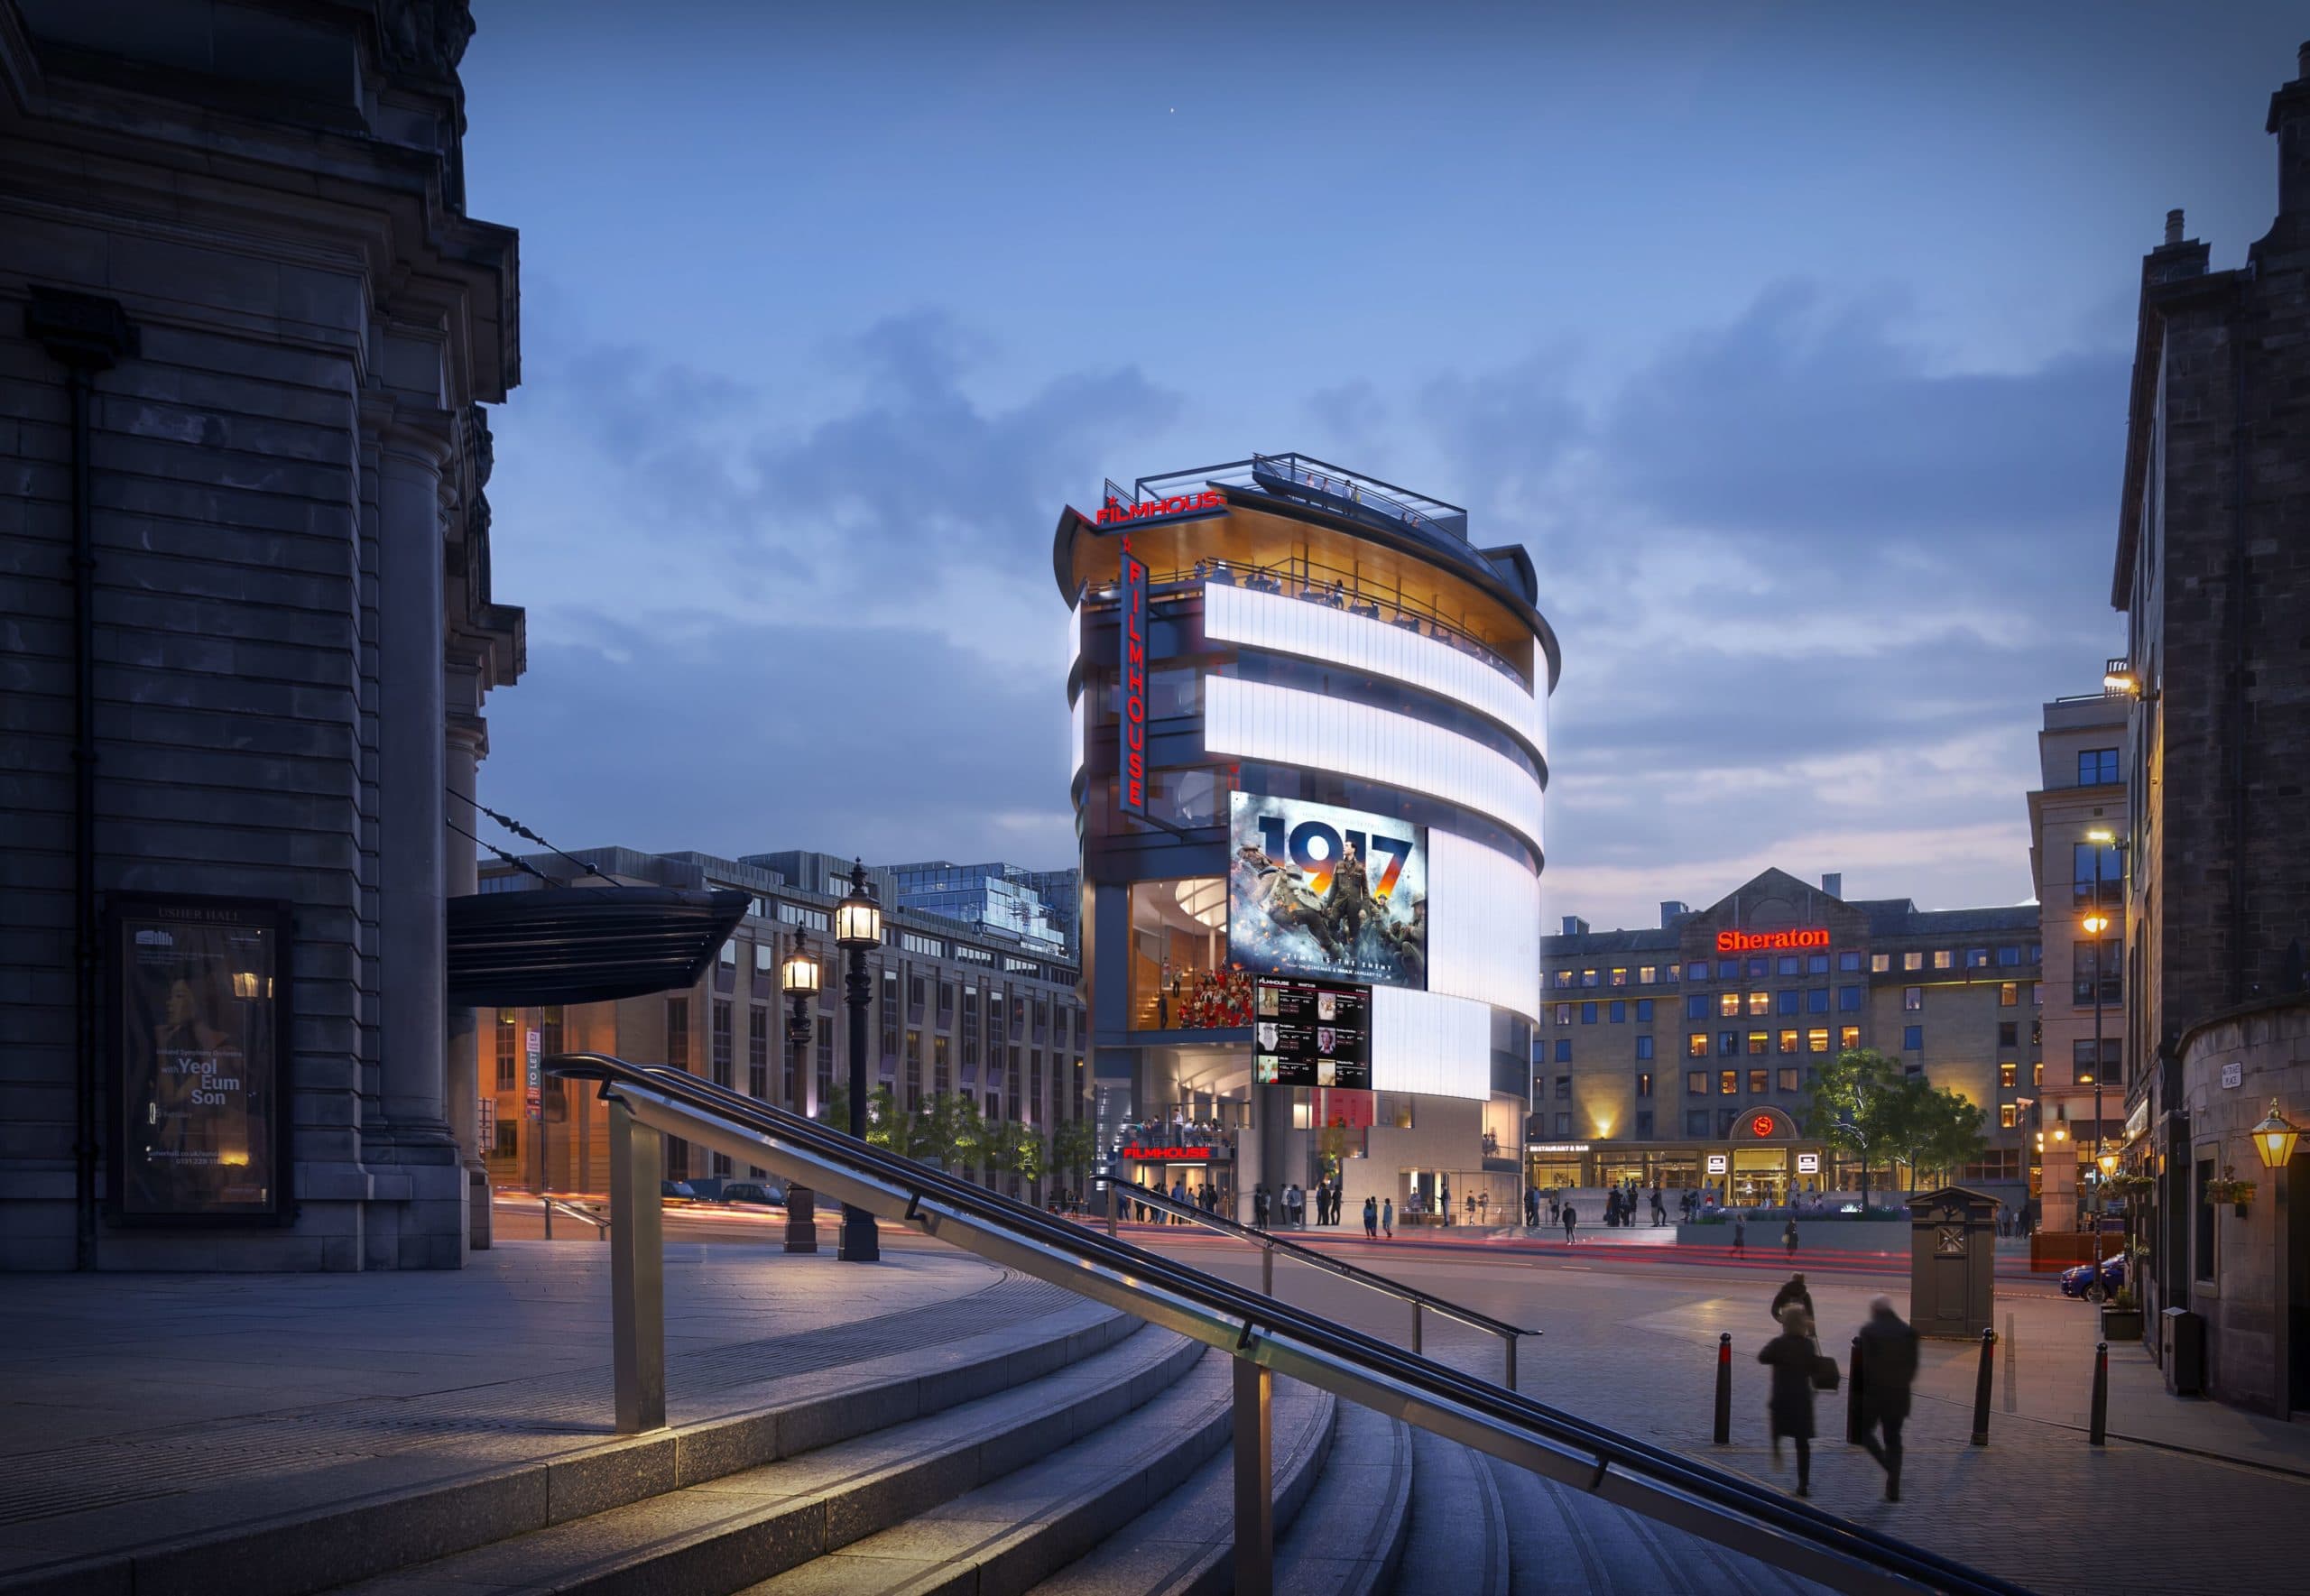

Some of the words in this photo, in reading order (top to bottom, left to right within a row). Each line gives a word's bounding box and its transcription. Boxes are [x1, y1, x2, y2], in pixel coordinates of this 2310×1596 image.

[1128, 560, 1144, 807] FILMHOUSE
[1259, 816, 1413, 901] 1917
[1717, 928, 1829, 951] Sheraton
[1338, 958, 1355, 966] THE
[1363, 961, 1391, 971] ENEMY
[179, 1058, 217, 1075] Yeol
[202, 1075, 240, 1090] Eum
[530, 1073, 537, 1085] TO
[191, 1089, 226, 1104] Son
[1123, 1146, 1211, 1158] FILMHOUSE
